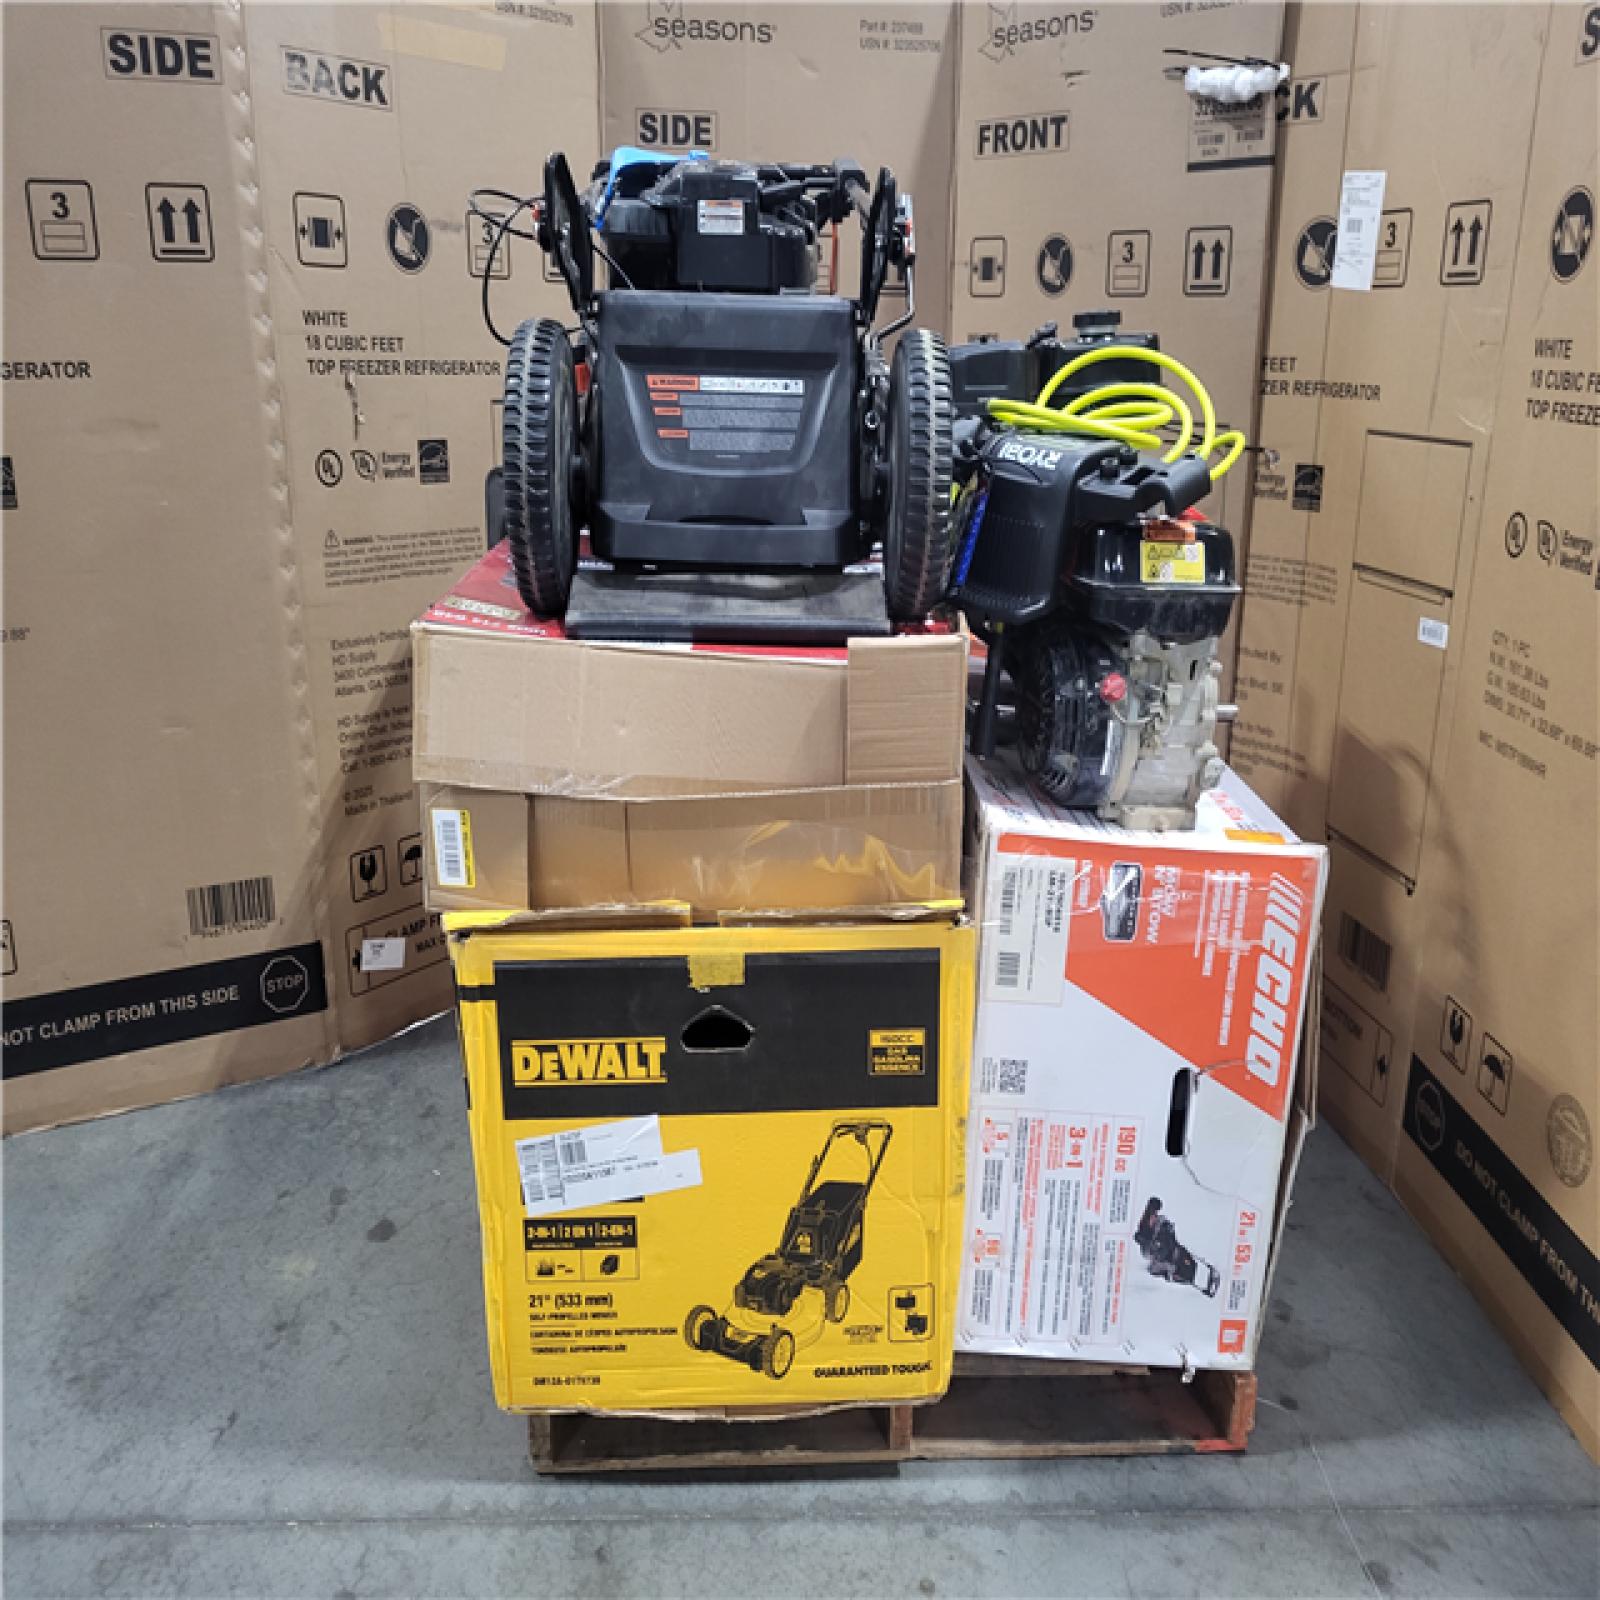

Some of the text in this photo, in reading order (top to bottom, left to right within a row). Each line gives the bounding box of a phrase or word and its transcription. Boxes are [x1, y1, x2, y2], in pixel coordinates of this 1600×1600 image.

[653, 16, 773, 44] seasons
[993, 10, 1094, 48] seasons
[108, 33, 214, 79] SIDE
[285, 51, 389, 105] BACK
[639, 112, 712, 147] SIDE
[977, 115, 1067, 154] FRONT
[50, 192, 70, 219] 3
[1384, 222, 1396, 248] 3
[1121, 241, 1135, 263] 3
[302, 310, 348, 327] WHITE
[305, 335, 404, 352] 18 CUBIC FEET
[1534, 338, 1573, 359] WHITE
[306, 359, 501, 375] TOP FREEZER REFRIGERATOR
[1293, 380, 1380, 401] REFRIGERATOR
[1545, 369, 1585, 392] CUBIC
[1526, 398, 1550, 419] TOP
[266, 973, 303, 993] STOP
[1245, 903, 1301, 1088] ECHO
[39, 1015, 101, 1040] CLAMP
[106, 1003, 156, 1026] FROM
[159, 994, 198, 1015] THIS
[201, 984, 241, 1007] SIDE
[1116, 1126, 1137, 1155] 190
[1539, 1237, 1579, 1295] FROM
[529, 1294, 551, 1308] 21"
